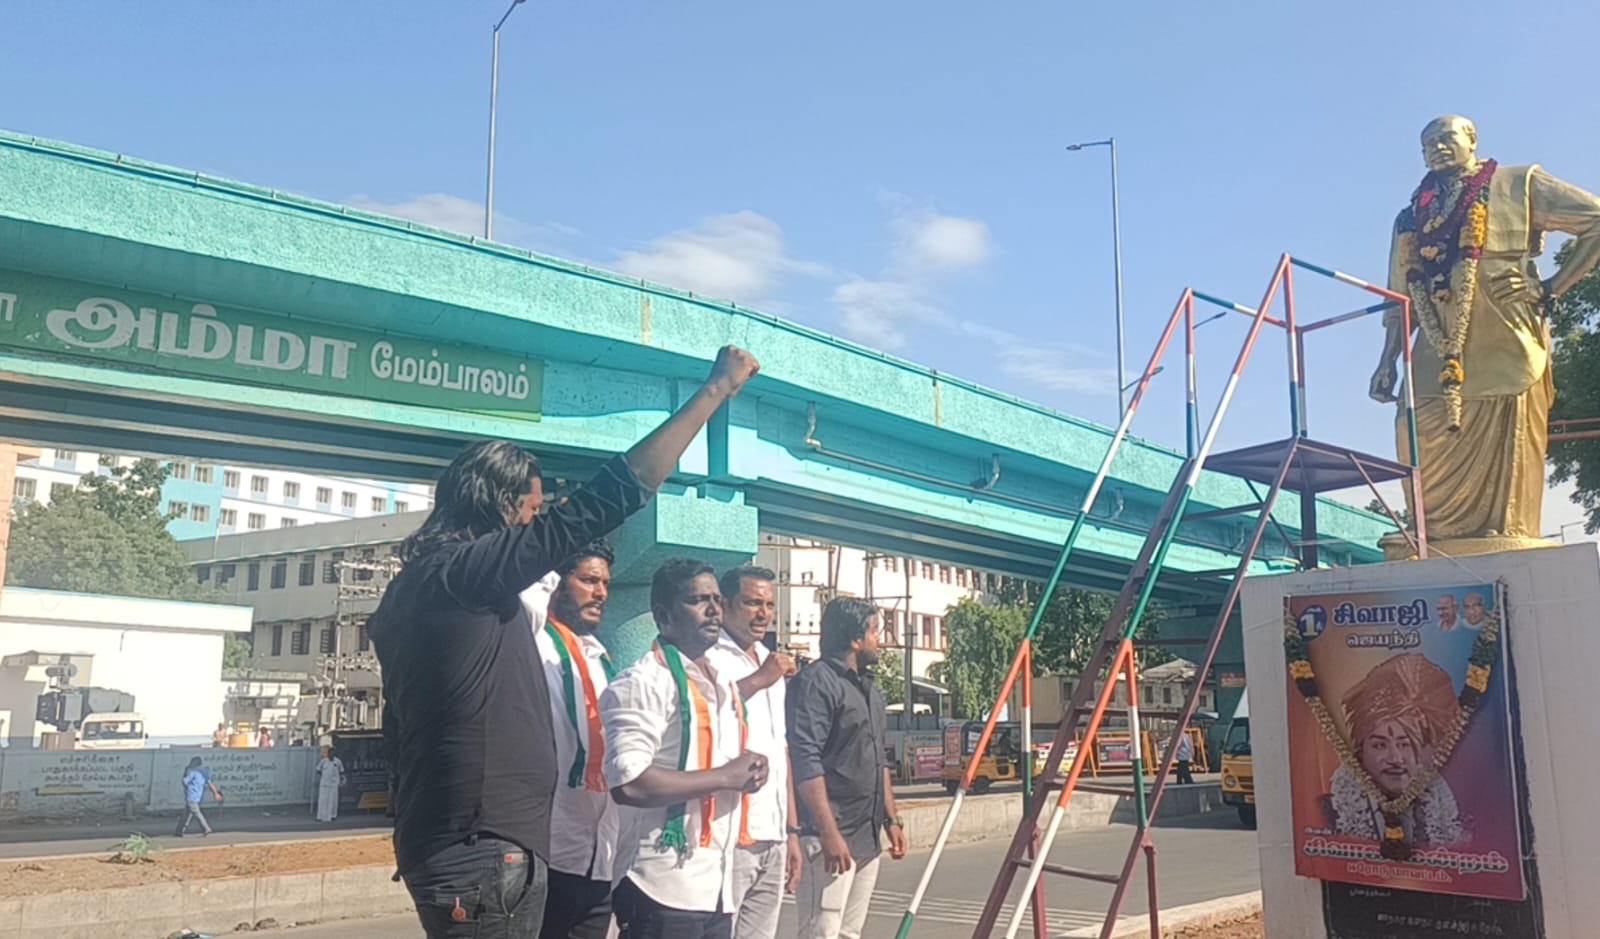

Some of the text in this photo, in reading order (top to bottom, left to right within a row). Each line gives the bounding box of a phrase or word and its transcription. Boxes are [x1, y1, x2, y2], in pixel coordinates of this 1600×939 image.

[46, 298, 357, 379] அம்மா
[370, 341, 530, 400] மேம்பாலம்
[1333, 599, 1430, 627] சிவாஜி
[1347, 630, 1421, 650] ஜெயந்தி
